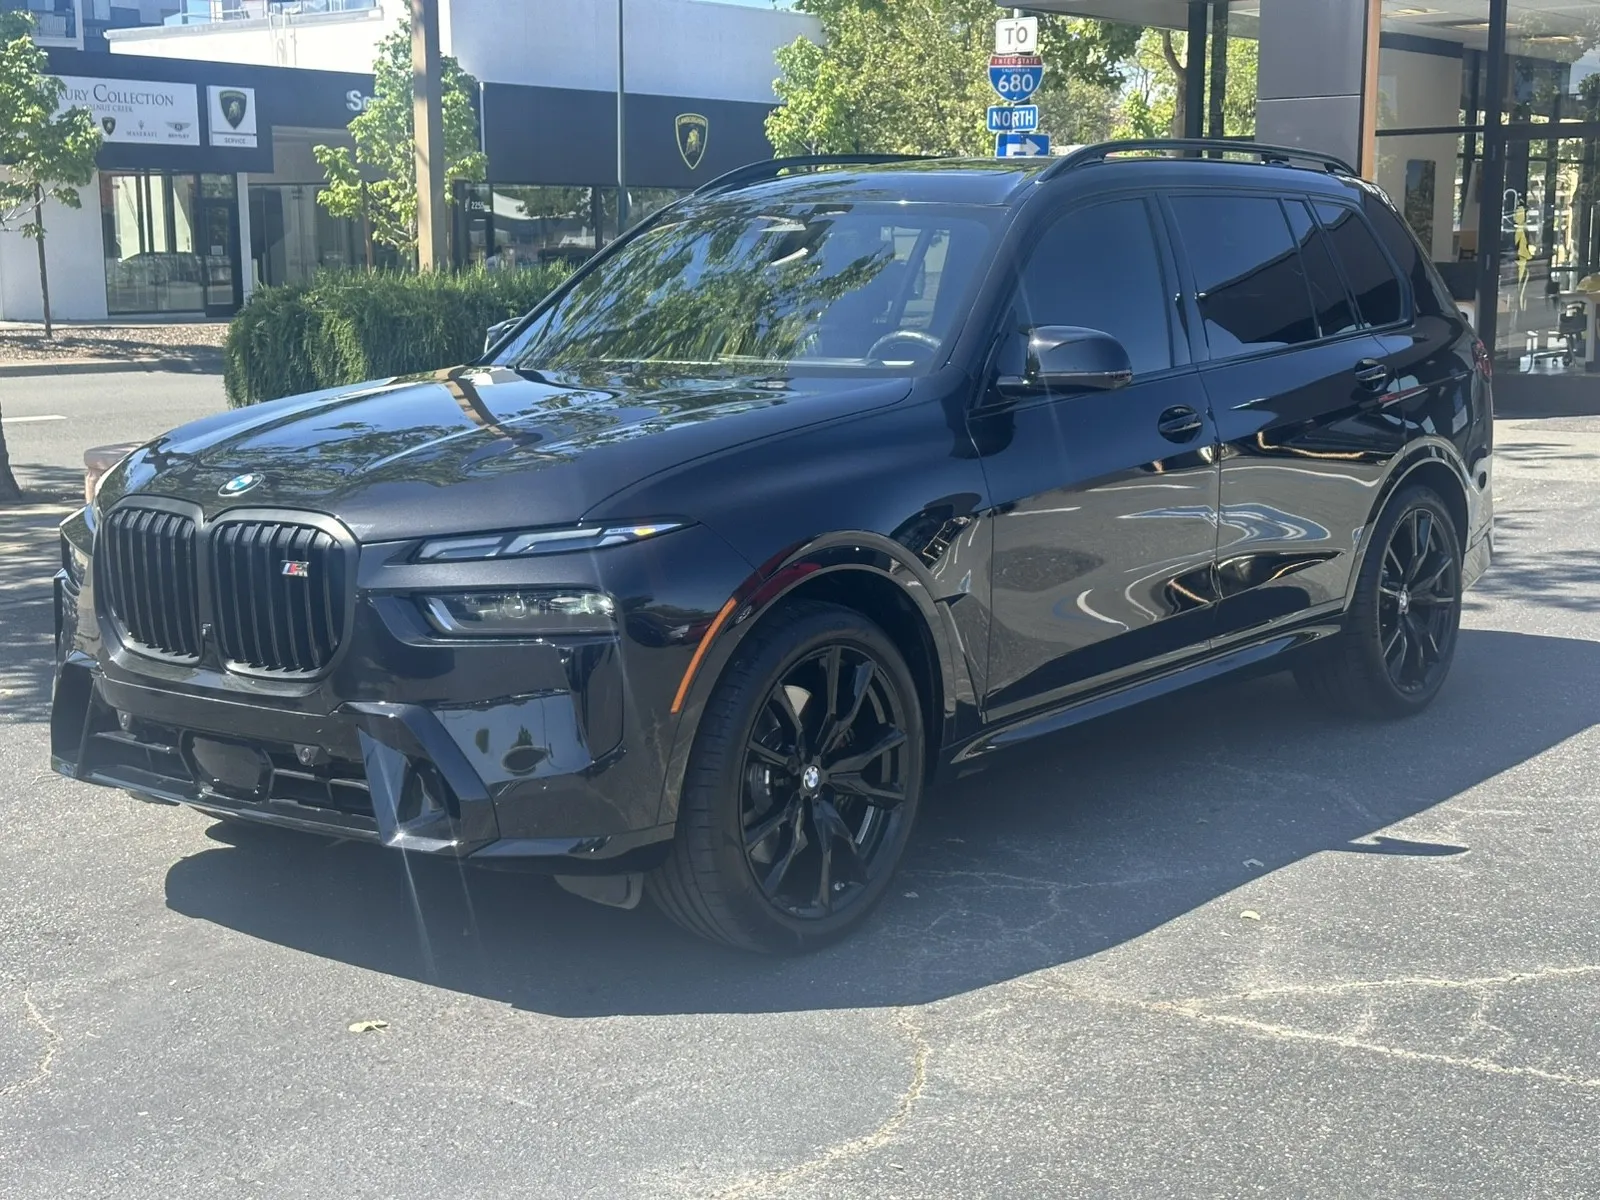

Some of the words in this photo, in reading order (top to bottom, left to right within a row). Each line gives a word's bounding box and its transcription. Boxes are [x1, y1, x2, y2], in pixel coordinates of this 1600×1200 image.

[1004, 26, 1028, 45] TO
[994, 57, 1038, 65] INTERSTATE
[998, 74, 1034, 92] 680
[93, 83, 175, 107] COLLECTION
[992, 109, 1034, 128] NORTH
[126, 130, 158, 138] MASERATI
[223, 137, 247, 145] SERVICE
